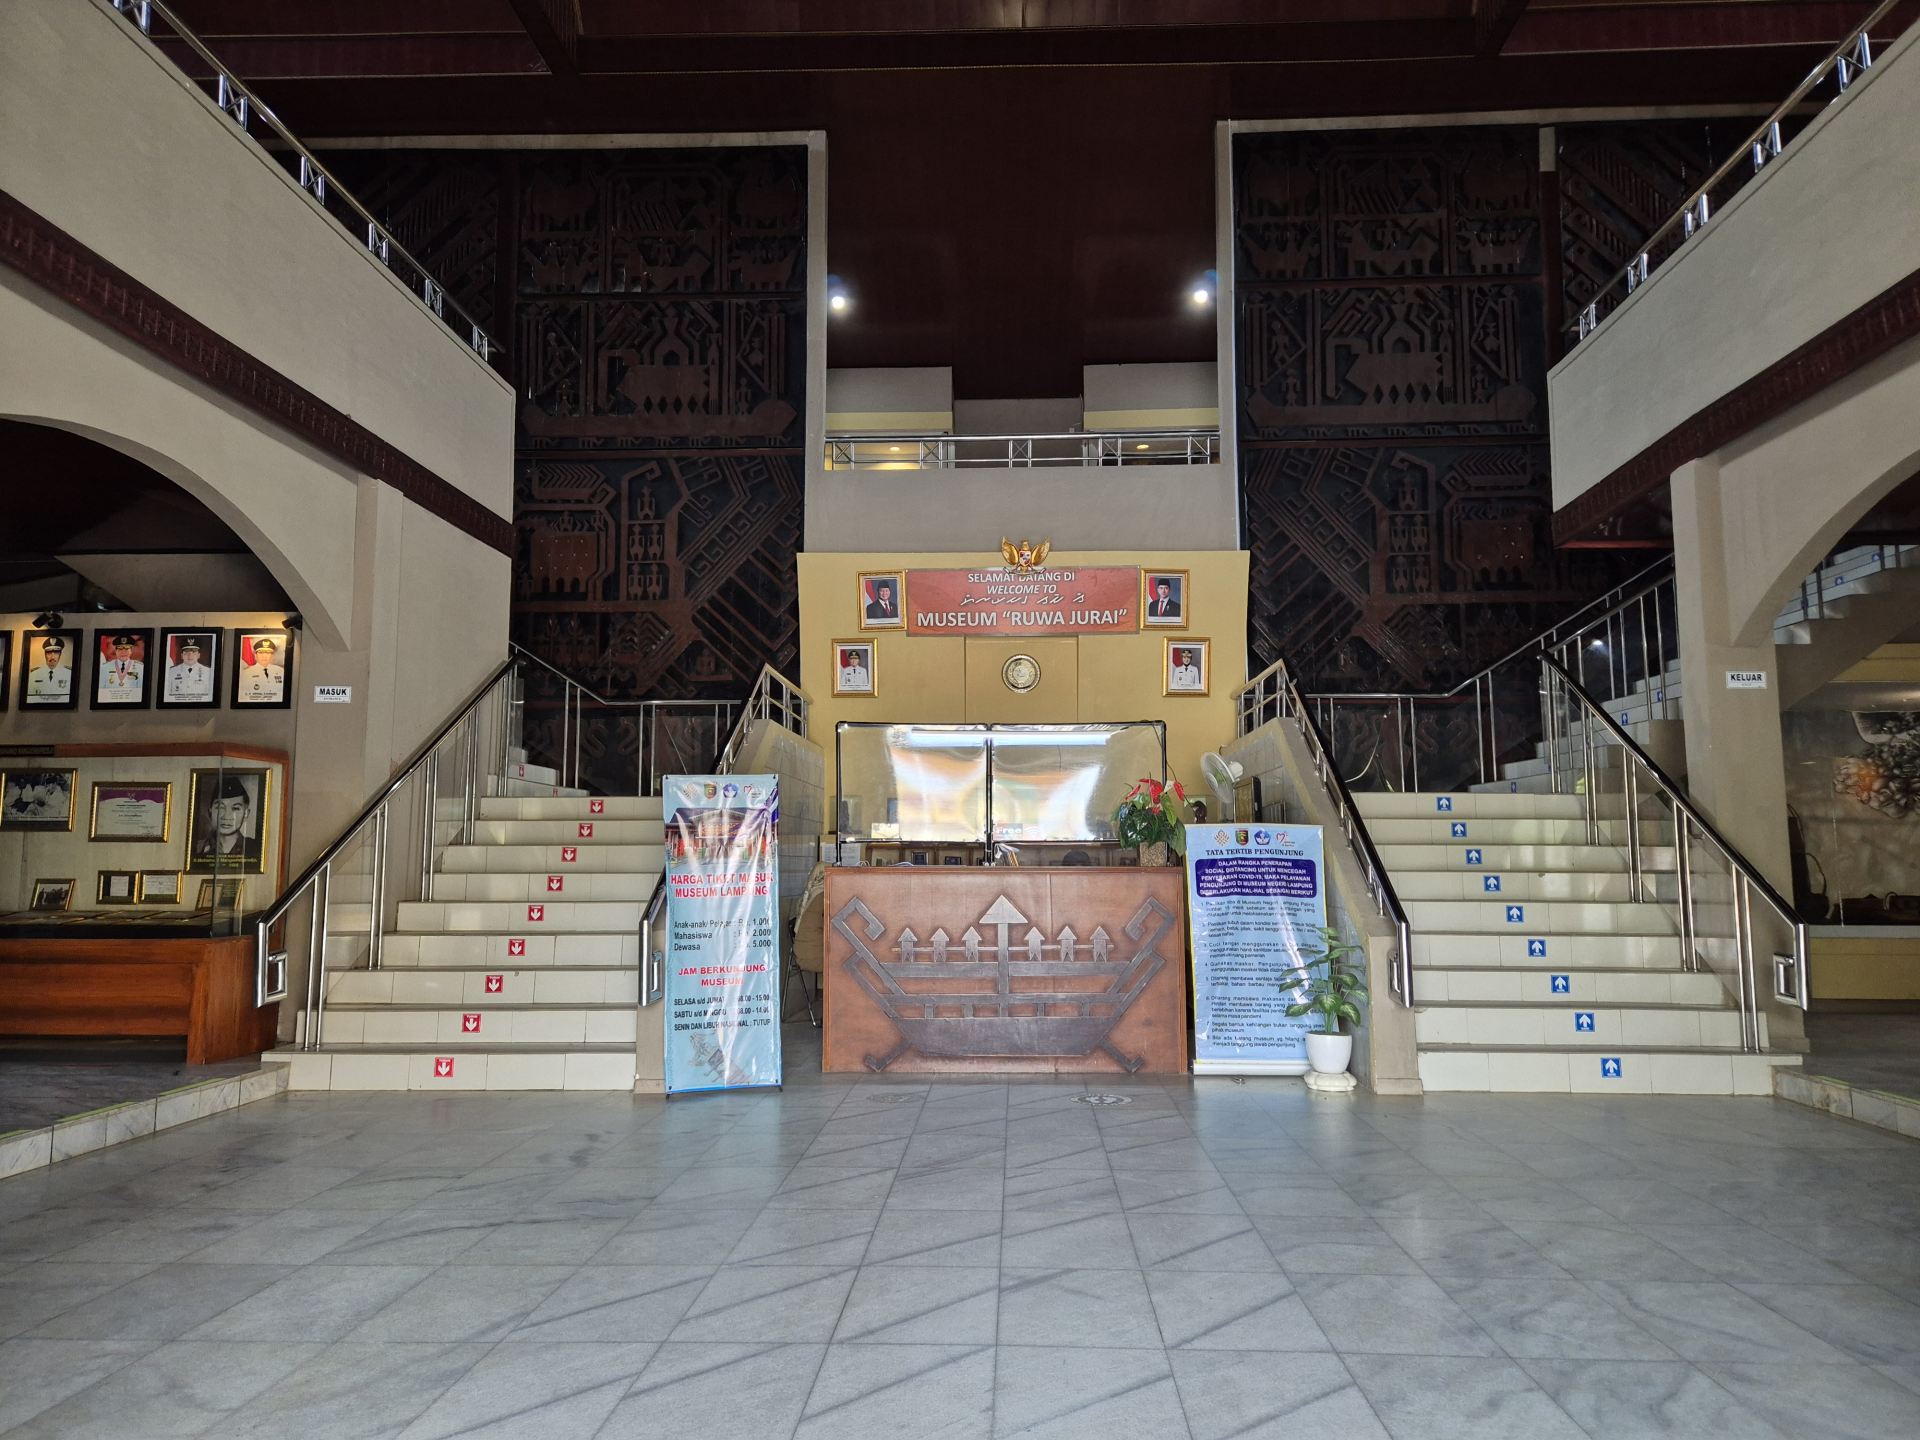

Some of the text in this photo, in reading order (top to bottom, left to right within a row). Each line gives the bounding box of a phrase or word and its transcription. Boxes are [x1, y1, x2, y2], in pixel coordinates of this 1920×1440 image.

[967, 573, 1015, 583] SELAMAT
[1064, 572, 1075, 581] DI
[987, 584, 1057, 595] WELCOME TO
[917, 611, 997, 627] MUSEUM
[1730, 673, 1763, 681] KELUAR
[319, 688, 347, 696] MASUK
[671, 874, 703, 884] HARGA
[675, 886, 768, 897] MUSEUM LAMPNG
[674, 943, 700, 951] Dewasa
[702, 978, 743, 986] MUSEUM
[675, 1023, 689, 1031] SENIN
